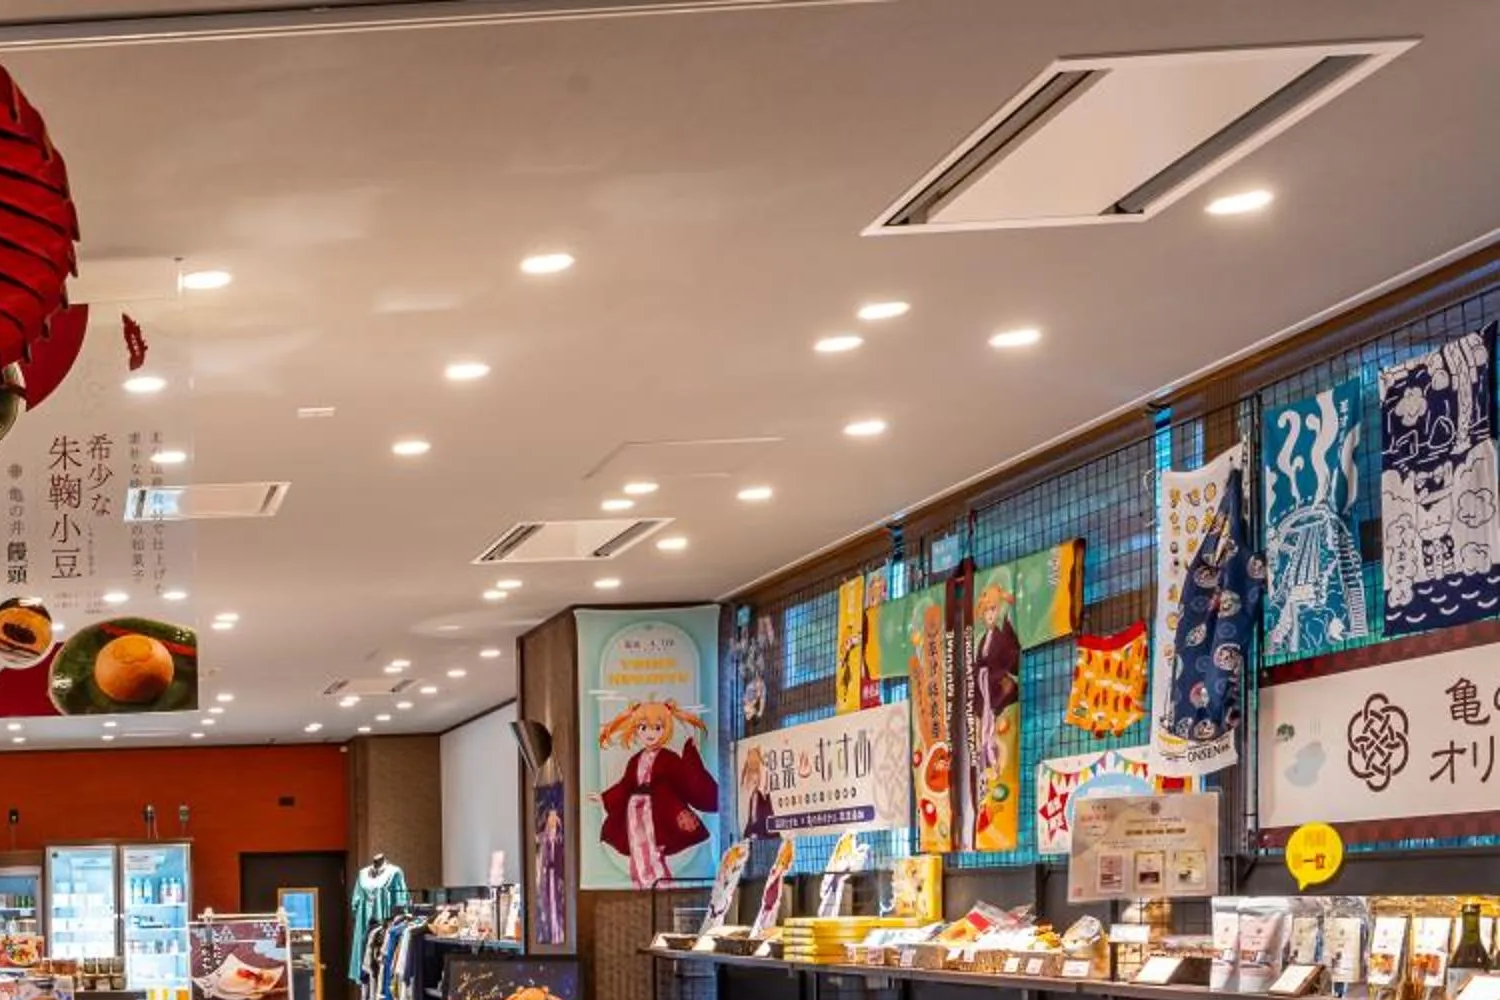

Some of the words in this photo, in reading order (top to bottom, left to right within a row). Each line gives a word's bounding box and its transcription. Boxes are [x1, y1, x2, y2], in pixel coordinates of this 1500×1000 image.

[48, 434, 83, 580] 朱鞠小豆
[87, 433, 114, 516] 希少な
[1445, 677, 1500, 726] 亀
[1429, 735, 1495, 784] オリ
